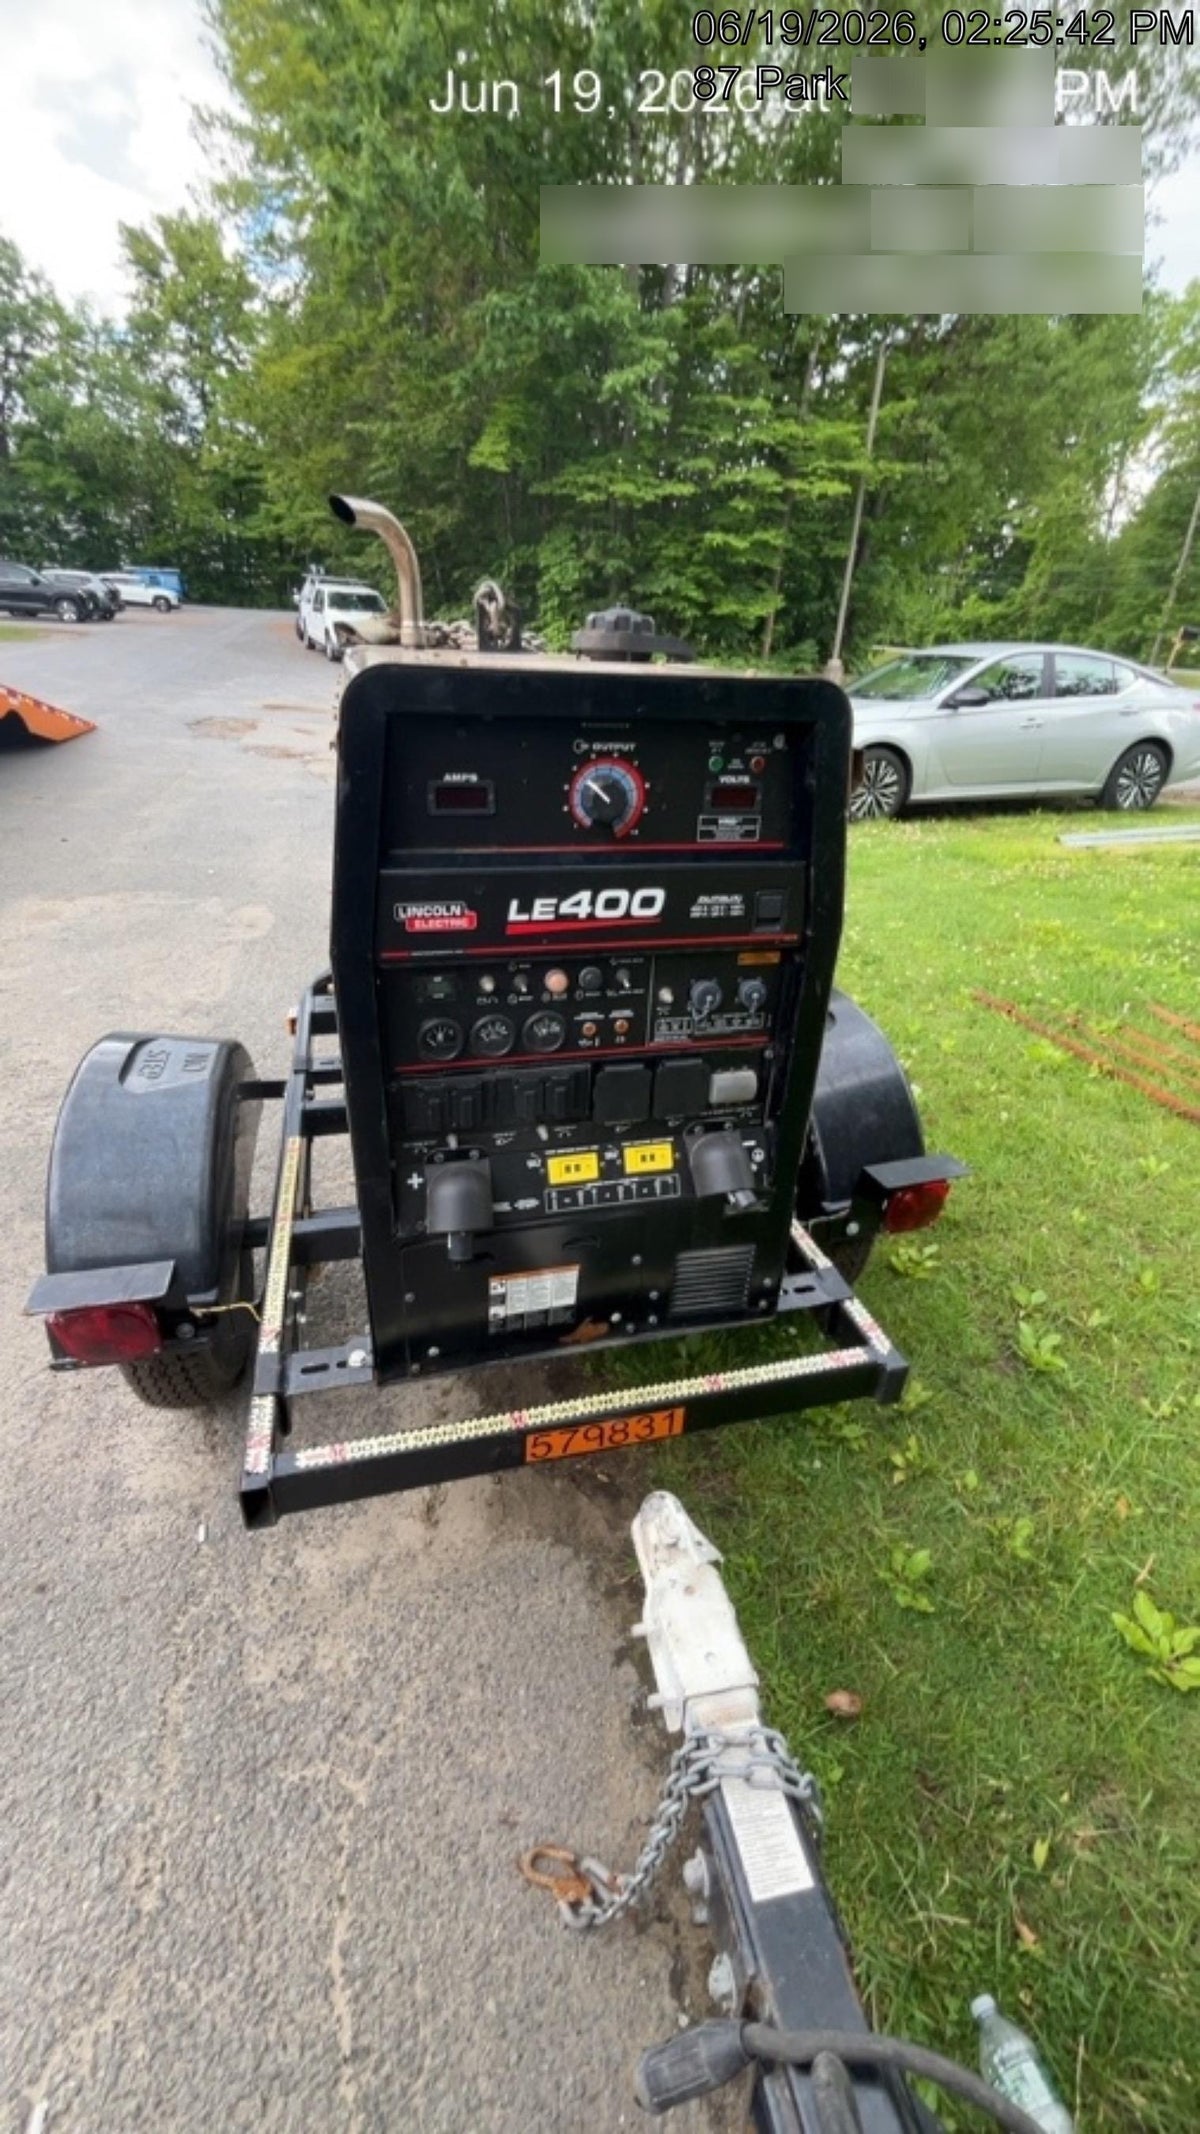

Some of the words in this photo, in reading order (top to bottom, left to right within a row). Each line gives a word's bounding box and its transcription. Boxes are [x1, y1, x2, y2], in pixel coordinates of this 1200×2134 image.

[442, 772, 478, 783] AMPS
[398, 904, 461, 919] LINCOLN
[507, 888, 665, 921] LE400
[530, 1411, 676, 1459] 579831
